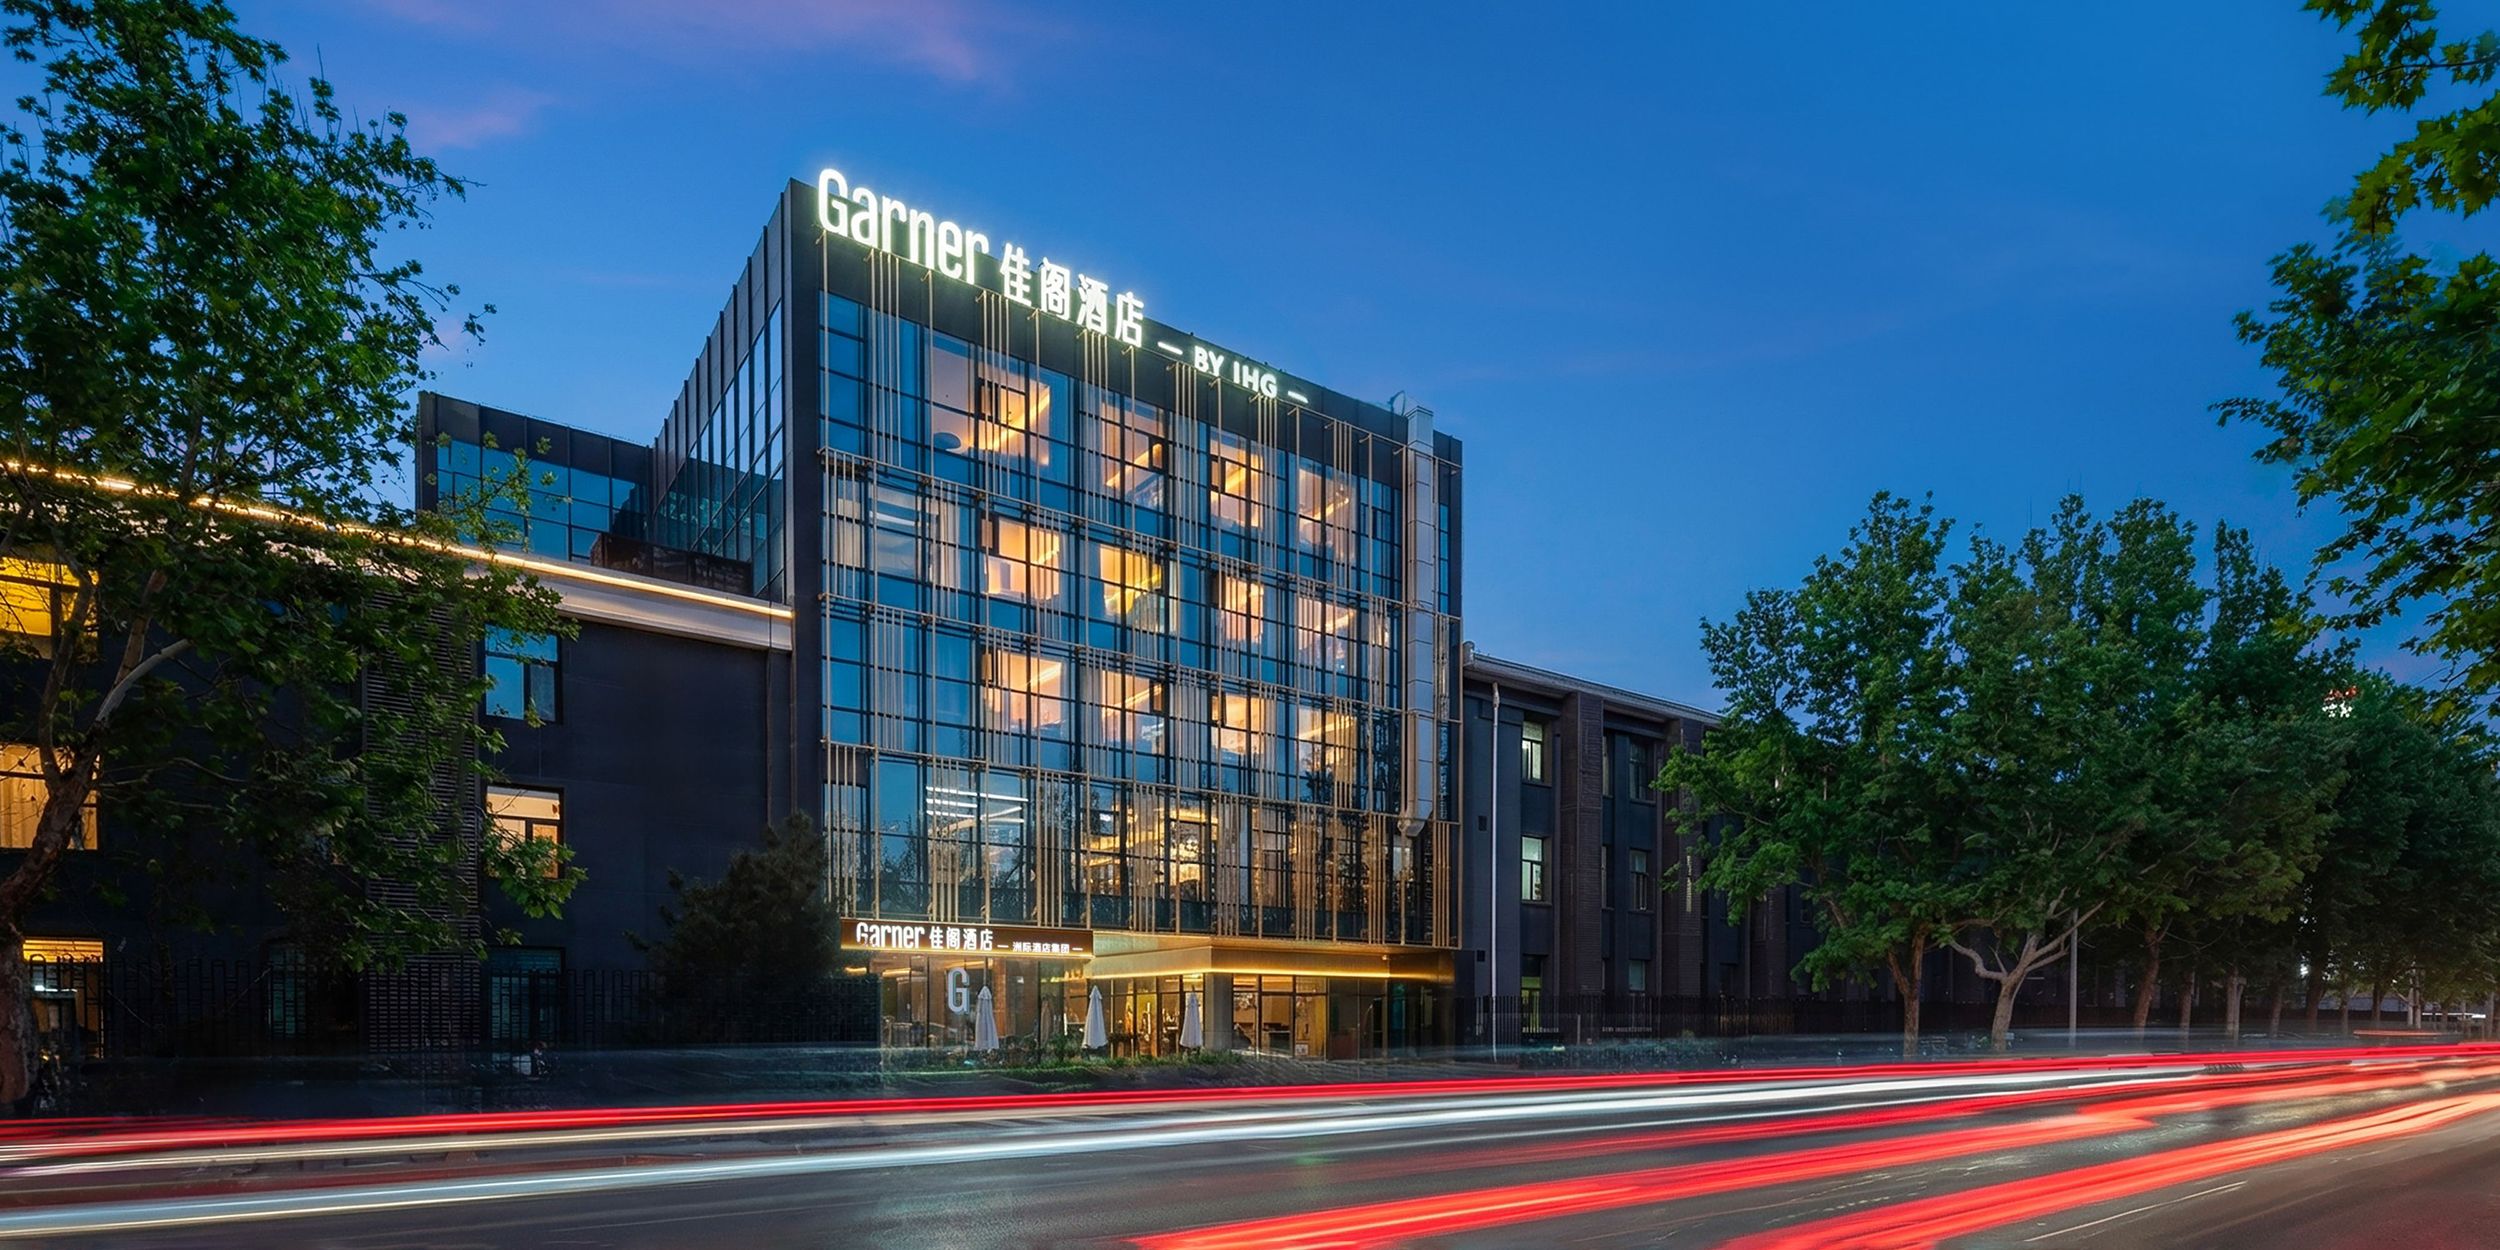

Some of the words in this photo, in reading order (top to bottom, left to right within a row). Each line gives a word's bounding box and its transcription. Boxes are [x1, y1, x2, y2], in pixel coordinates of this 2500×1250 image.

[817, 167, 990, 285] Garner
[1000, 242, 1145, 348] 佳阁酒店
[1194, 345, 1225, 377] BY
[1233, 360, 1278, 399] IHG
[856, 921, 925, 949] Garner
[929, 926, 994, 951] 佳阁酒店
[947, 966, 970, 1016] G
